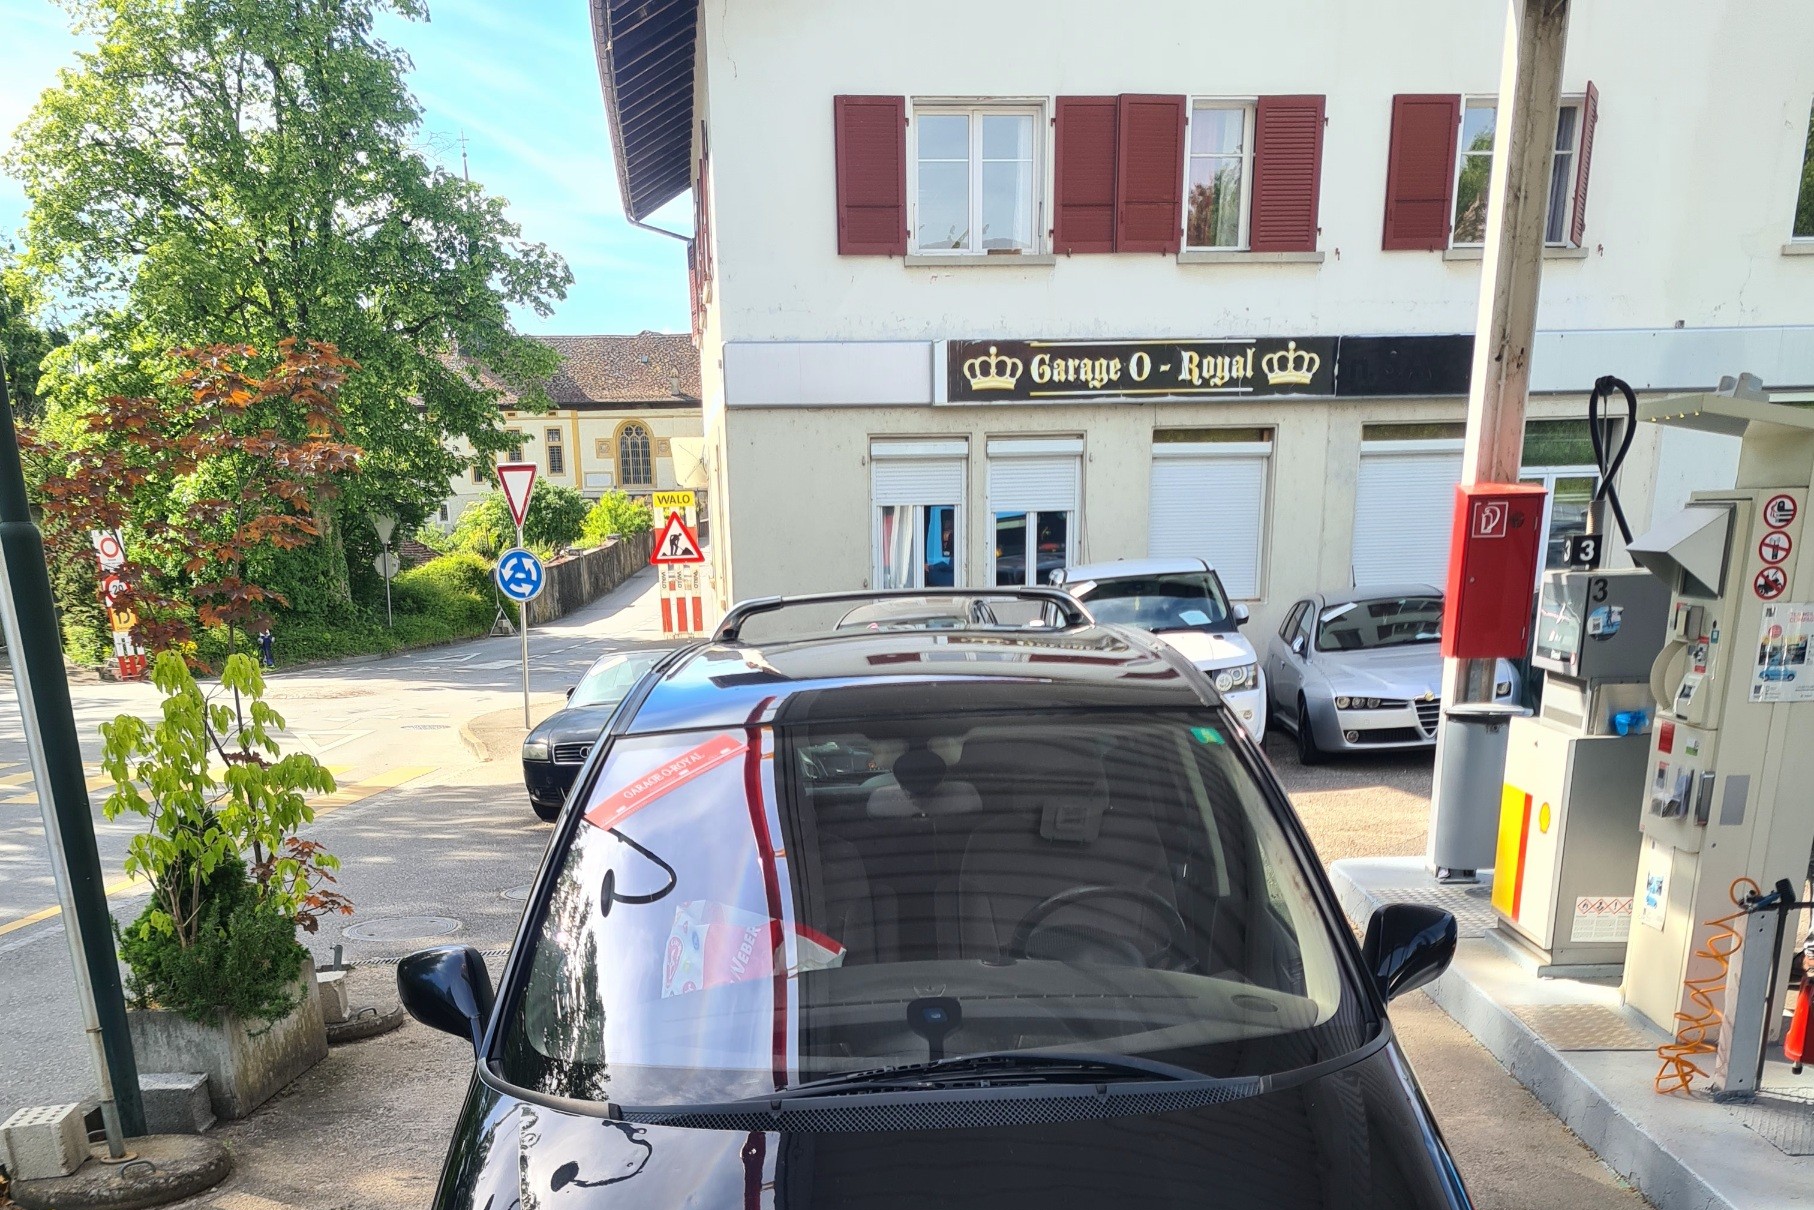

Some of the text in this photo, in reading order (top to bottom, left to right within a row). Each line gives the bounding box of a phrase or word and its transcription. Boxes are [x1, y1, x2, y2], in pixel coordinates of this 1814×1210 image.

[1030, 351, 1122, 388] Garage
[1128, 350, 1152, 382] O
[1177, 347, 1256, 387] Royal
[657, 494, 691, 504] WALO
[1563, 540, 1571, 562] 3
[1579, 540, 1595, 561] 3
[1593, 578, 1608, 602] 3
[624, 752, 705, 799] GARAGE O-ROYAL
